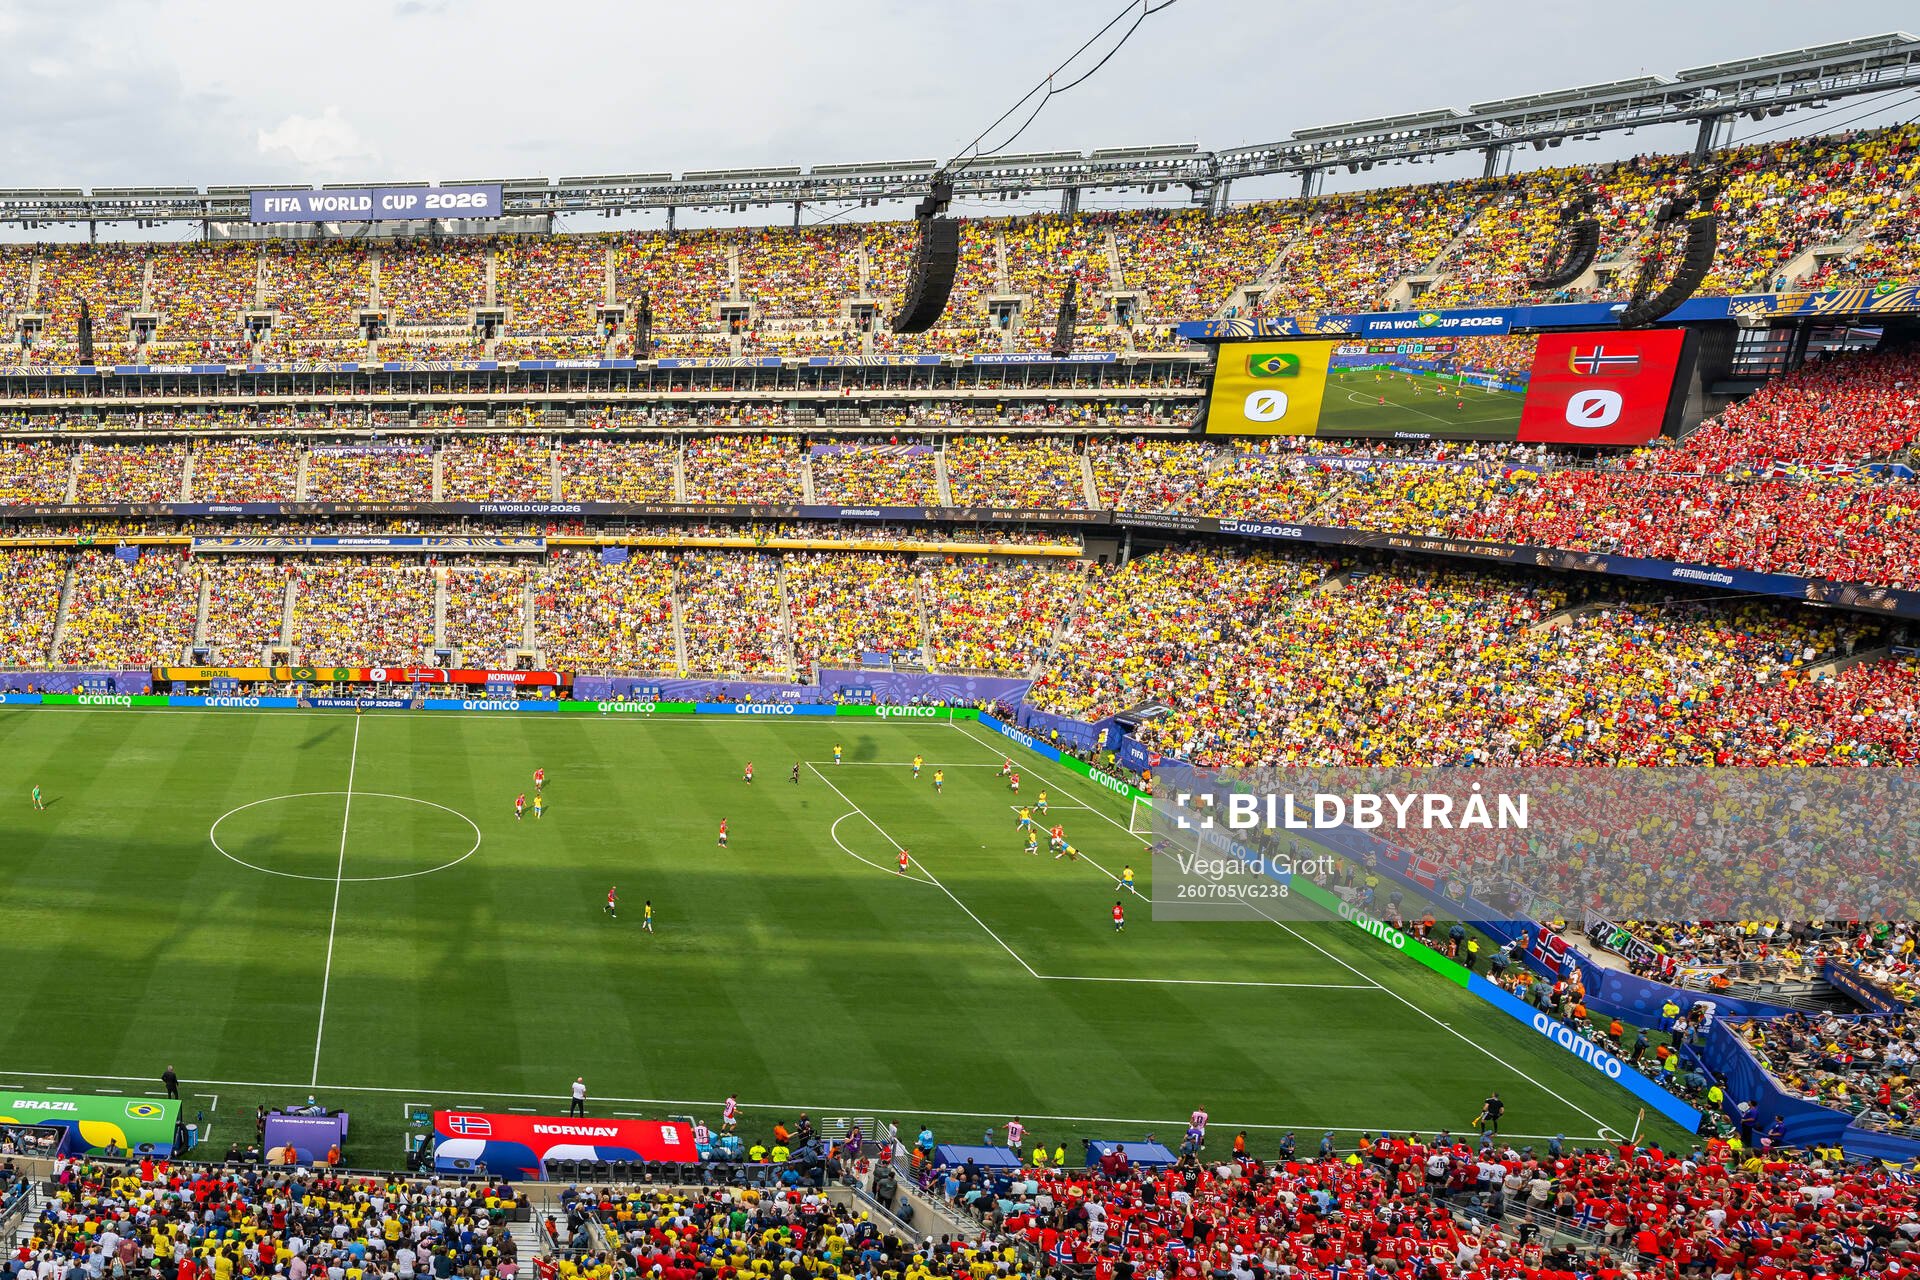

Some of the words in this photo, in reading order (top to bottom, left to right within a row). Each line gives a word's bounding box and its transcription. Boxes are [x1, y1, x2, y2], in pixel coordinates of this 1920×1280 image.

[264, 197, 301, 212] FIFA
[309, 196, 372, 212] WORLD
[382, 195, 418, 210] CUP
[425, 192, 489, 209] 2026
[1369, 320, 1392, 330] FIFA
[1461, 316, 1503, 327] 2026
[979, 355, 1003, 363] NEW
[1005, 354, 1037, 362] YORK
[1244, 390, 1288, 423] 0
[1565, 389, 1623, 428] 0
[1395, 431, 1431, 439] Hisense
[841, 508, 880, 517] #FIFAWorldCup
[992, 511, 1013, 519] NEW
[1239, 524, 1262, 534] CUP
[1263, 526, 1302, 537] 2026
[1389, 537, 1412, 548] NEW
[1672, 567, 1733, 585] #FIFAWorldCup
[200, 670, 231, 678] BRAZIL
[488, 673, 526, 682] NORWAY
[78, 694, 131, 706] aramco
[205, 696, 259, 707] aramco
[318, 699, 336, 707] FIFA
[376, 700, 402, 708] 2026
[463, 699, 519, 711] aramco
[598, 701, 656, 713] aramco
[735, 702, 794, 714] aramco
[876, 705, 936, 717] aramco
[1001, 724, 1033, 748] aramco
[1131, 748, 1144, 761] FIFA
[1089, 767, 1129, 797] aramco
[1337, 900, 1405, 949] aramco
[1562, 953, 1577, 971] IFA
[1533, 1012, 1622, 1079] aramco
[12, 1100, 78, 1112] BRAZIL
[533, 1124, 618, 1137] NORWAY
[1381, 1142, 1390, 1150] 10
[1205, 1194, 1214, 1203] 23
[1110, 1222, 1119, 1230] 10
[1405, 1242, 1412, 1250] 6
[183, 1261, 188, 1269] 9
[1103, 1262, 1112, 1272] 10
[1568, 1257, 1578, 1266] 14
